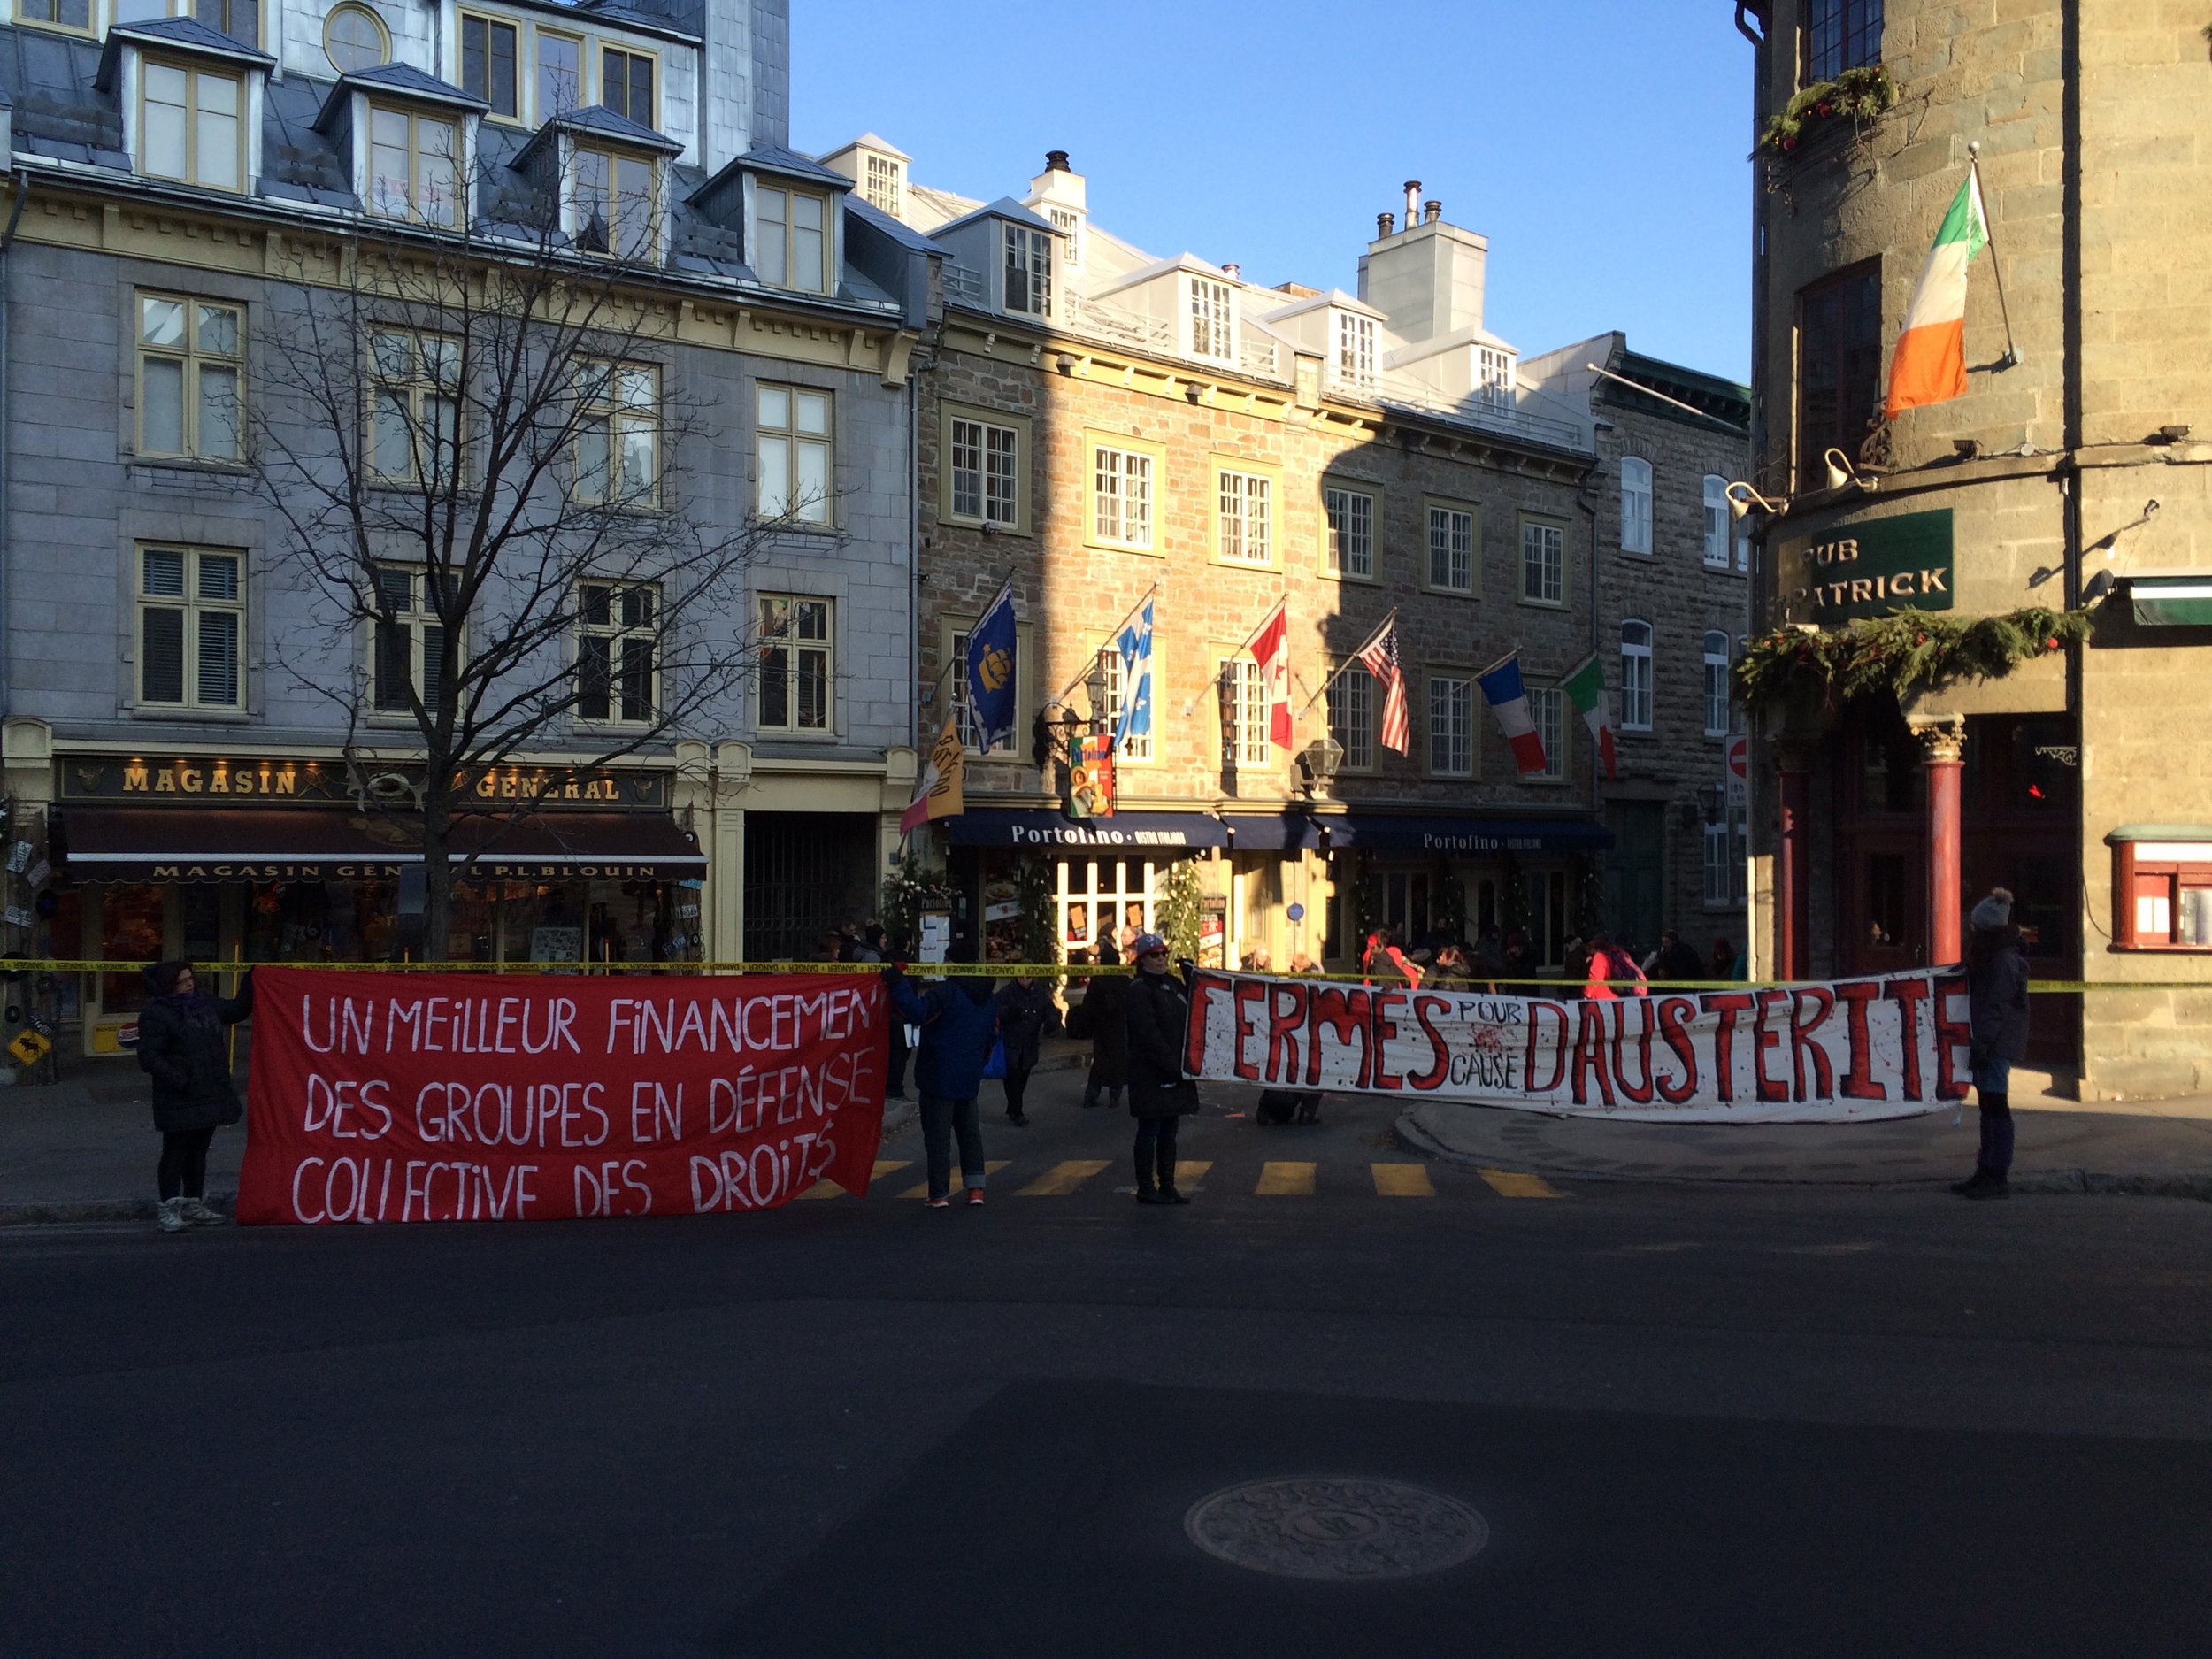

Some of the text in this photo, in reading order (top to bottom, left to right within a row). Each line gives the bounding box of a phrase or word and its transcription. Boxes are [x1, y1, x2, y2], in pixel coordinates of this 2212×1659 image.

[1801, 538, 1859, 567] PUB
[122, 767, 296, 795] MAGASIN
[1011, 825, 1124, 844] Portofino
[1423, 833, 1499, 850] Portofino
[153, 865, 319, 877] MAGASIN
[303, 994, 373, 1055] UN
[1458, 999, 1522, 1025] POUR
[1183, 975, 1453, 1092] FERMES
[1450, 1053, 1519, 1091] CAUSE
[303, 1046, 876, 1148] DES GROUPES EN DÉFENSE
[573, 1159, 652, 1218] DES
